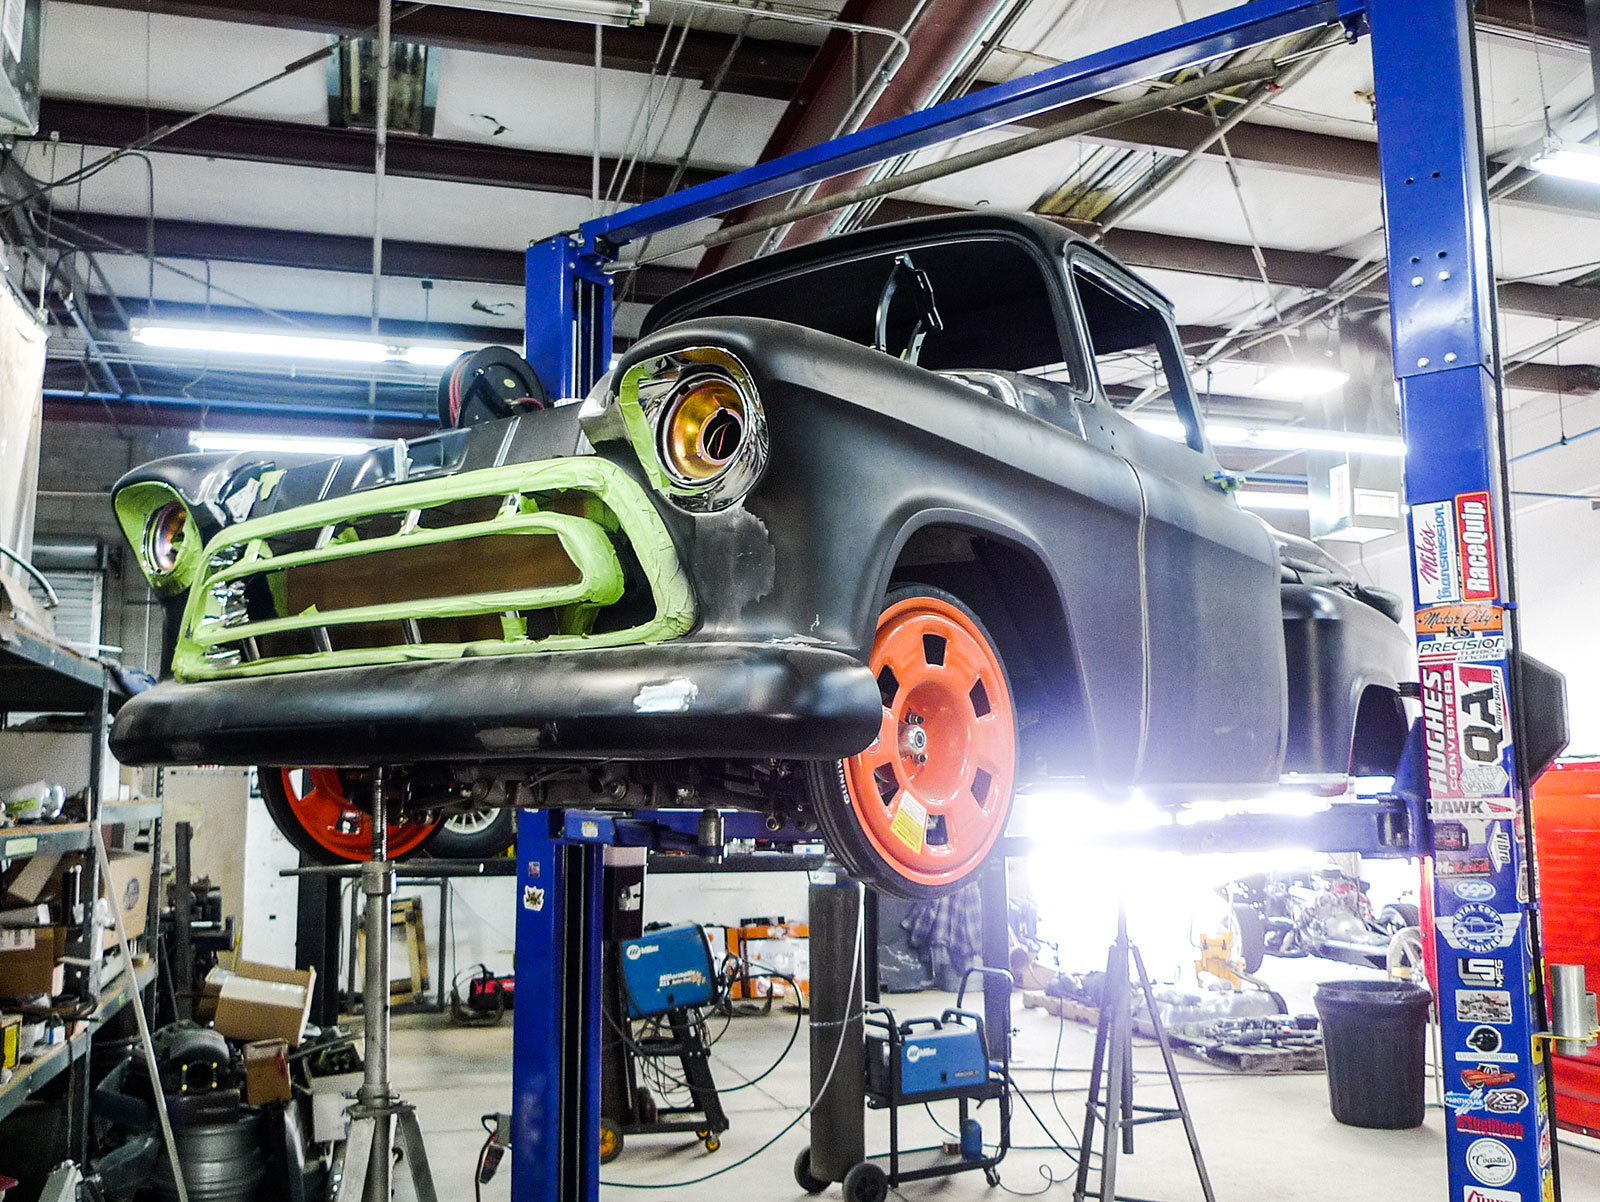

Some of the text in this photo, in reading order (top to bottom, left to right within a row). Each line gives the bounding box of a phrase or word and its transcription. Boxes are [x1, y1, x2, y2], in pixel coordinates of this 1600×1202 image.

[1416, 521, 1439, 585] Mike's
[1433, 504, 1452, 600] Transmission
[1462, 501, 1490, 592] RaceQuip
[1420, 638, 1504, 653] PRECISION
[1423, 609, 1493, 628] Motor City
[1459, 666, 1503, 763] QA1
[1493, 669, 1503, 726] DRIVESHAFTS
[1423, 668, 1449, 794] HUGHES
[1444, 669, 1458, 791] CONVERTERS
[1427, 801, 1484, 814] HAWK
[1478, 904, 1501, 922] COST
[1495, 959, 1504, 988] MFG
[1492, 1093, 1518, 1105] XS
